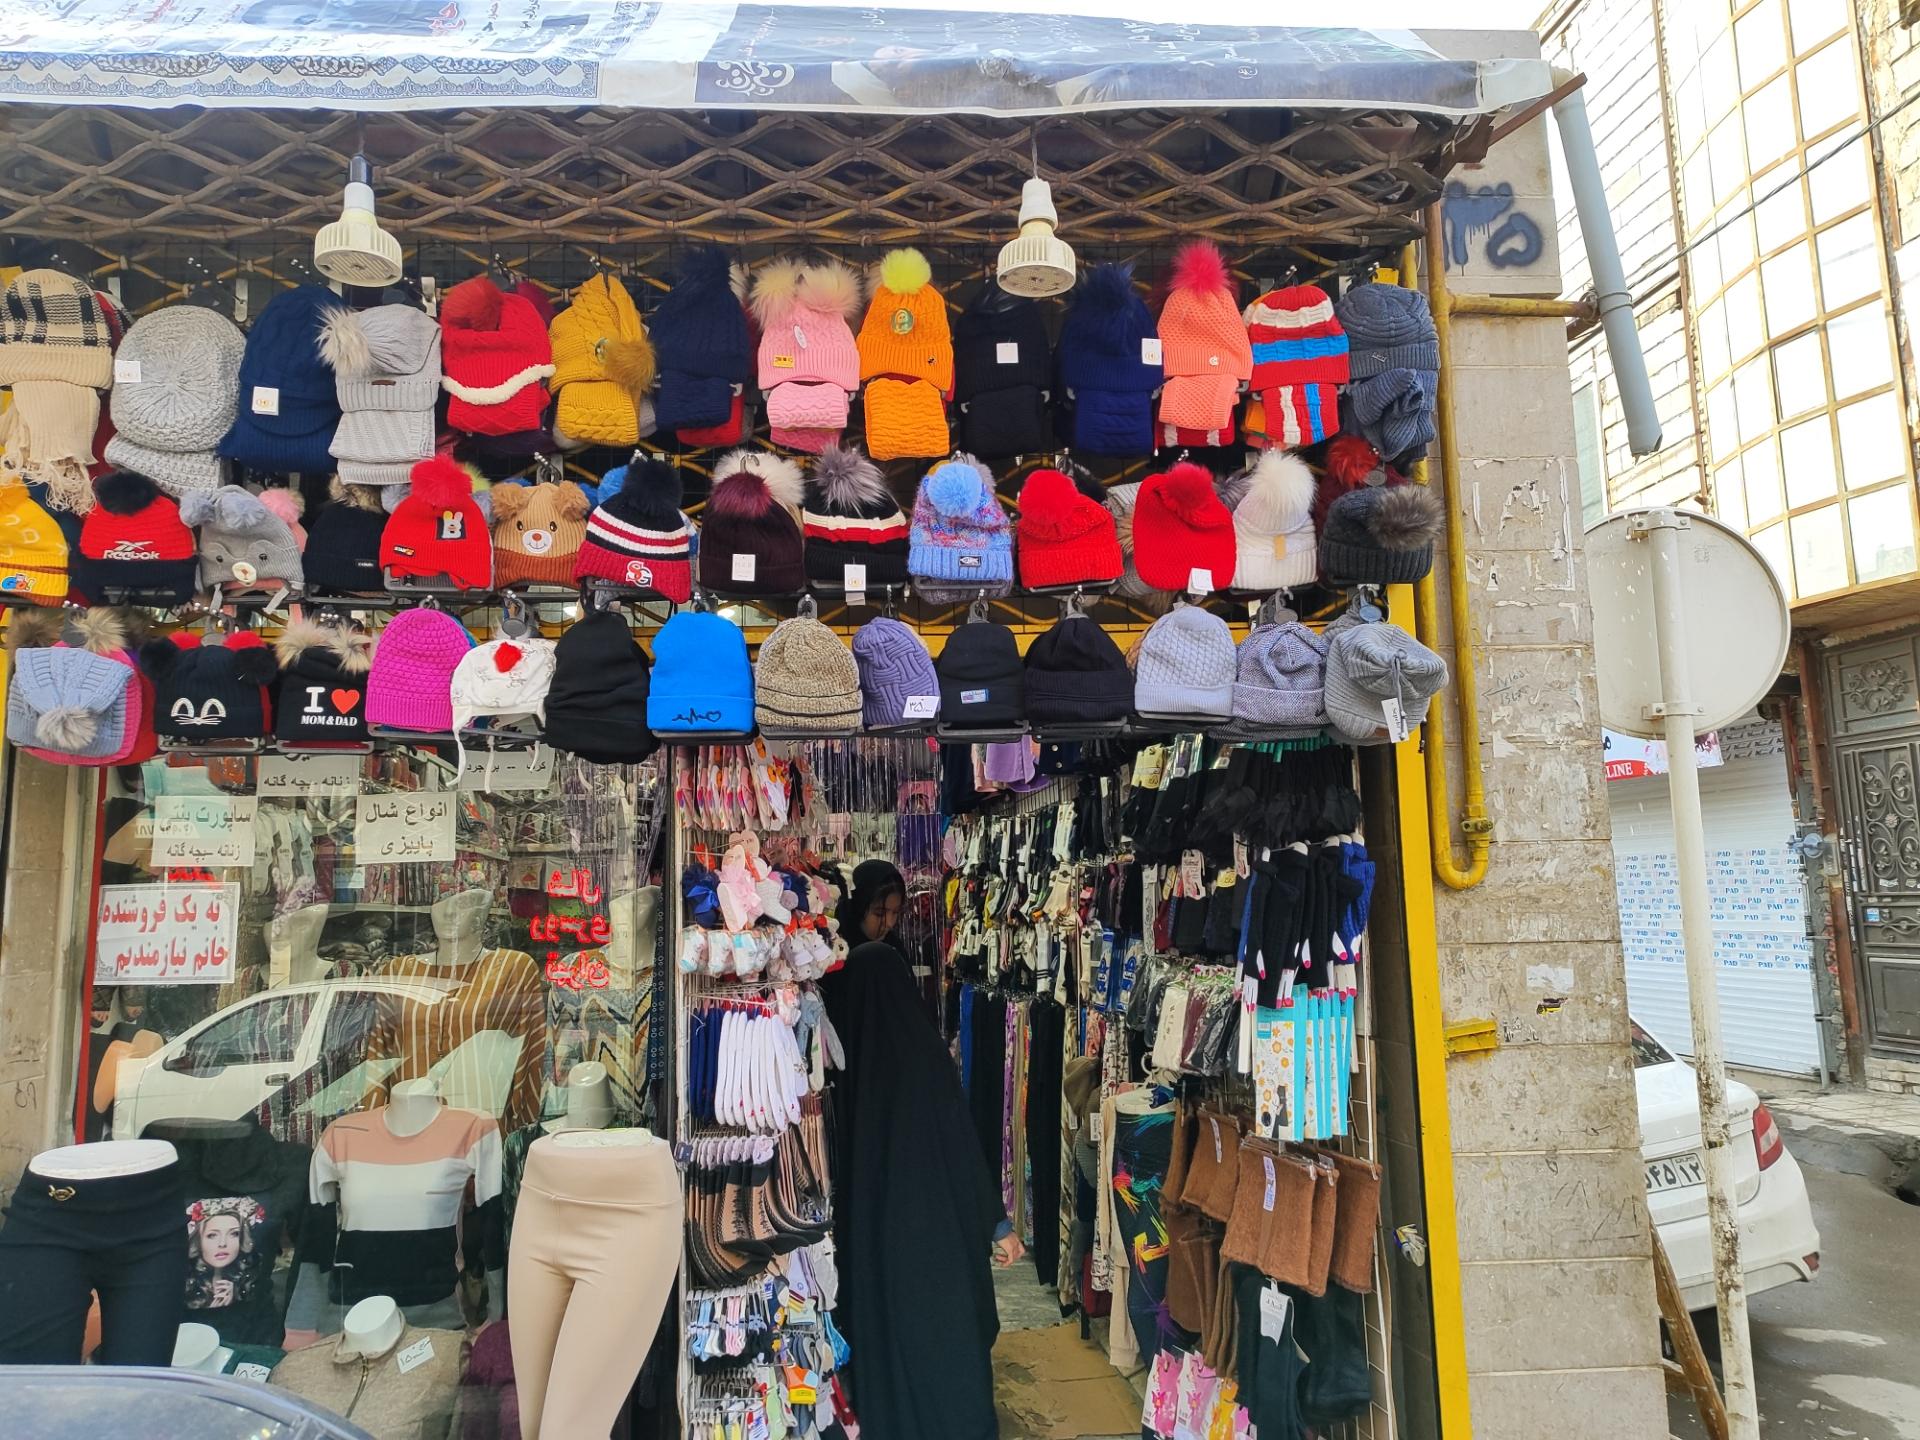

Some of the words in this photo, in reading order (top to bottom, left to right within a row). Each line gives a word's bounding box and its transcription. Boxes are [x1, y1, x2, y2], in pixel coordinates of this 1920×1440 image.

[103, 549, 160, 561] Reebok
[304, 687, 325, 713] I
[1605, 762, 1634, 778] LINE
[196, 803, 251, 832] ساپورت
[365, 802, 399, 823] شال
[405, 801, 448, 826] انواع
[167, 842, 186, 857] گانه
[218, 844, 241, 861] زنانه
[381, 835, 434, 857] پاییزی
[102, 892, 167, 933] فروشنده
[174, 893, 198, 930] یک
[205, 899, 220, 931] به
[113, 937, 187, 977] نیازمندیم
[193, 936, 227, 976] خانم
[1679, 1161, 1702, 1183] ۱۲
